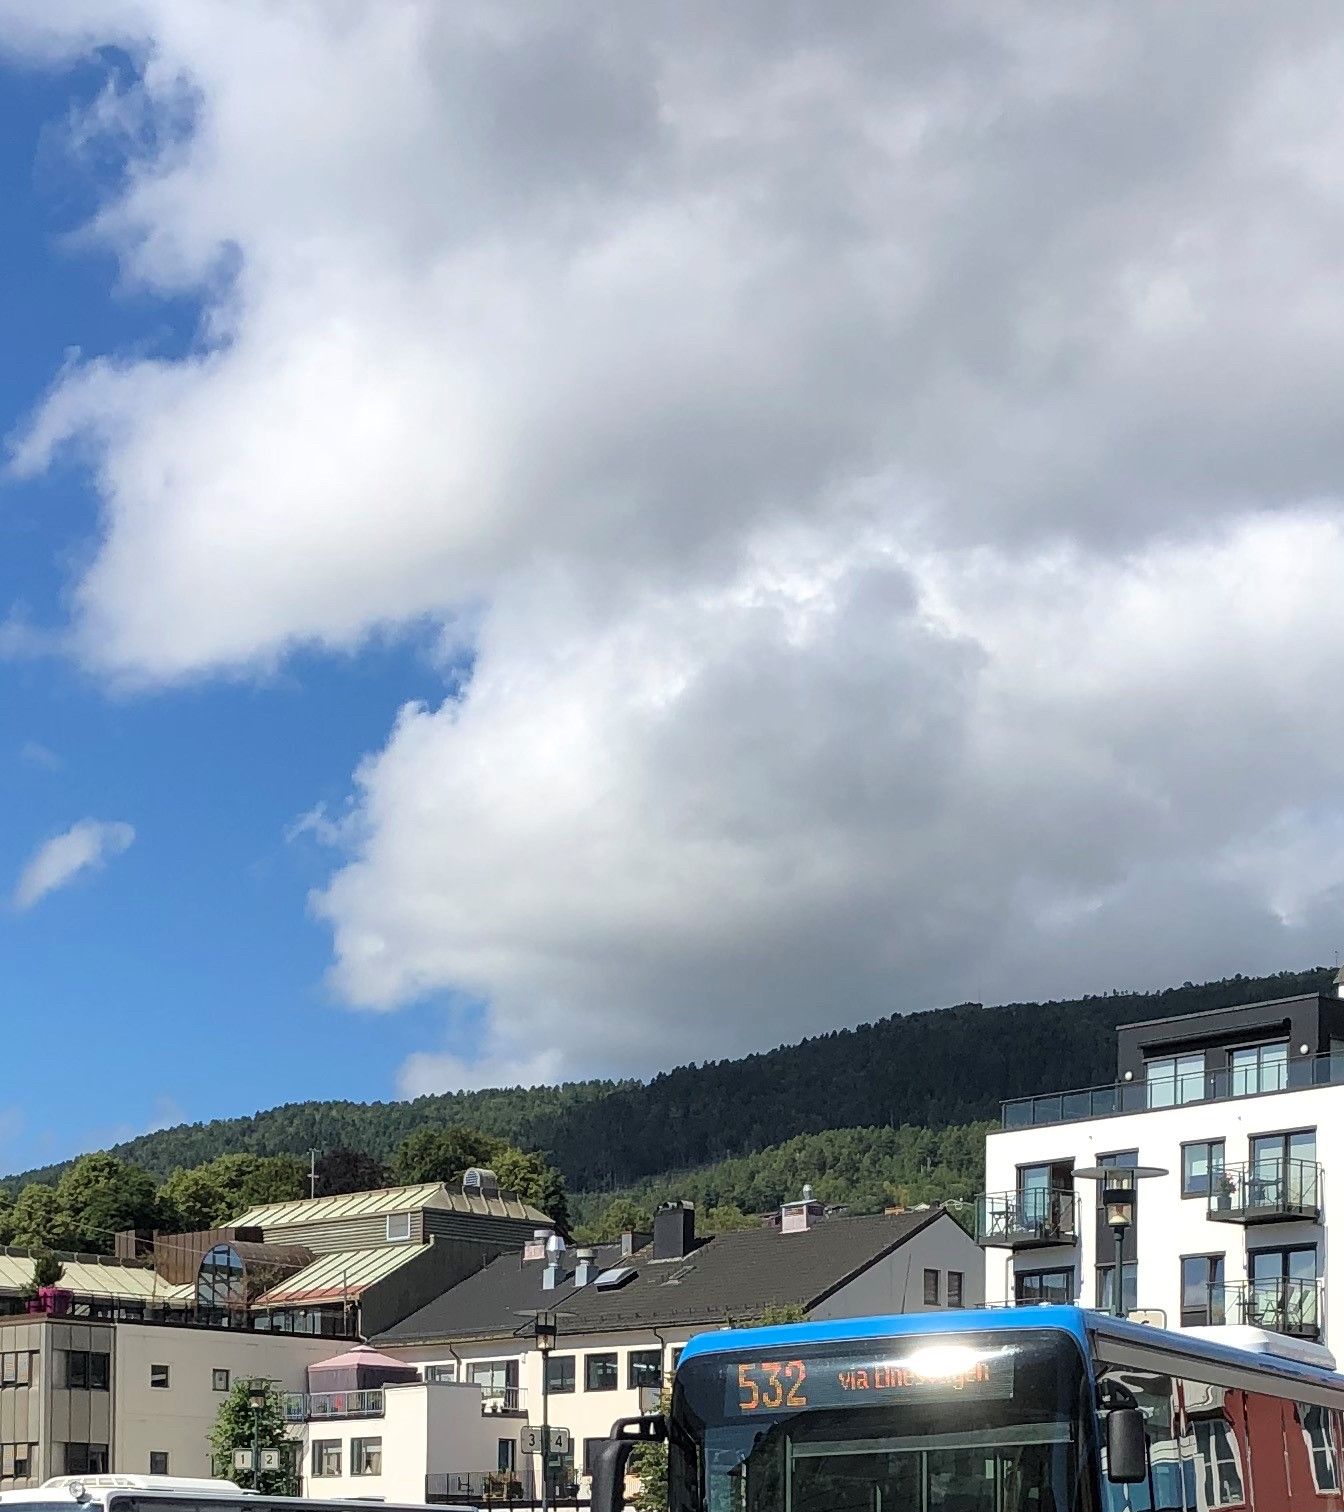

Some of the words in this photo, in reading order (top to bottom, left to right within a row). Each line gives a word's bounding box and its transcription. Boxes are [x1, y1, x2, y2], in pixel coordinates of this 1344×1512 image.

[737, 1359, 807, 1411] 532
[837, 1368, 869, 1391] via
[528, 1433, 536, 1447] 3
[554, 1435, 563, 1448] 4
[240, 1454, 245, 1465] 1
[266, 1454, 273, 1465] 2
